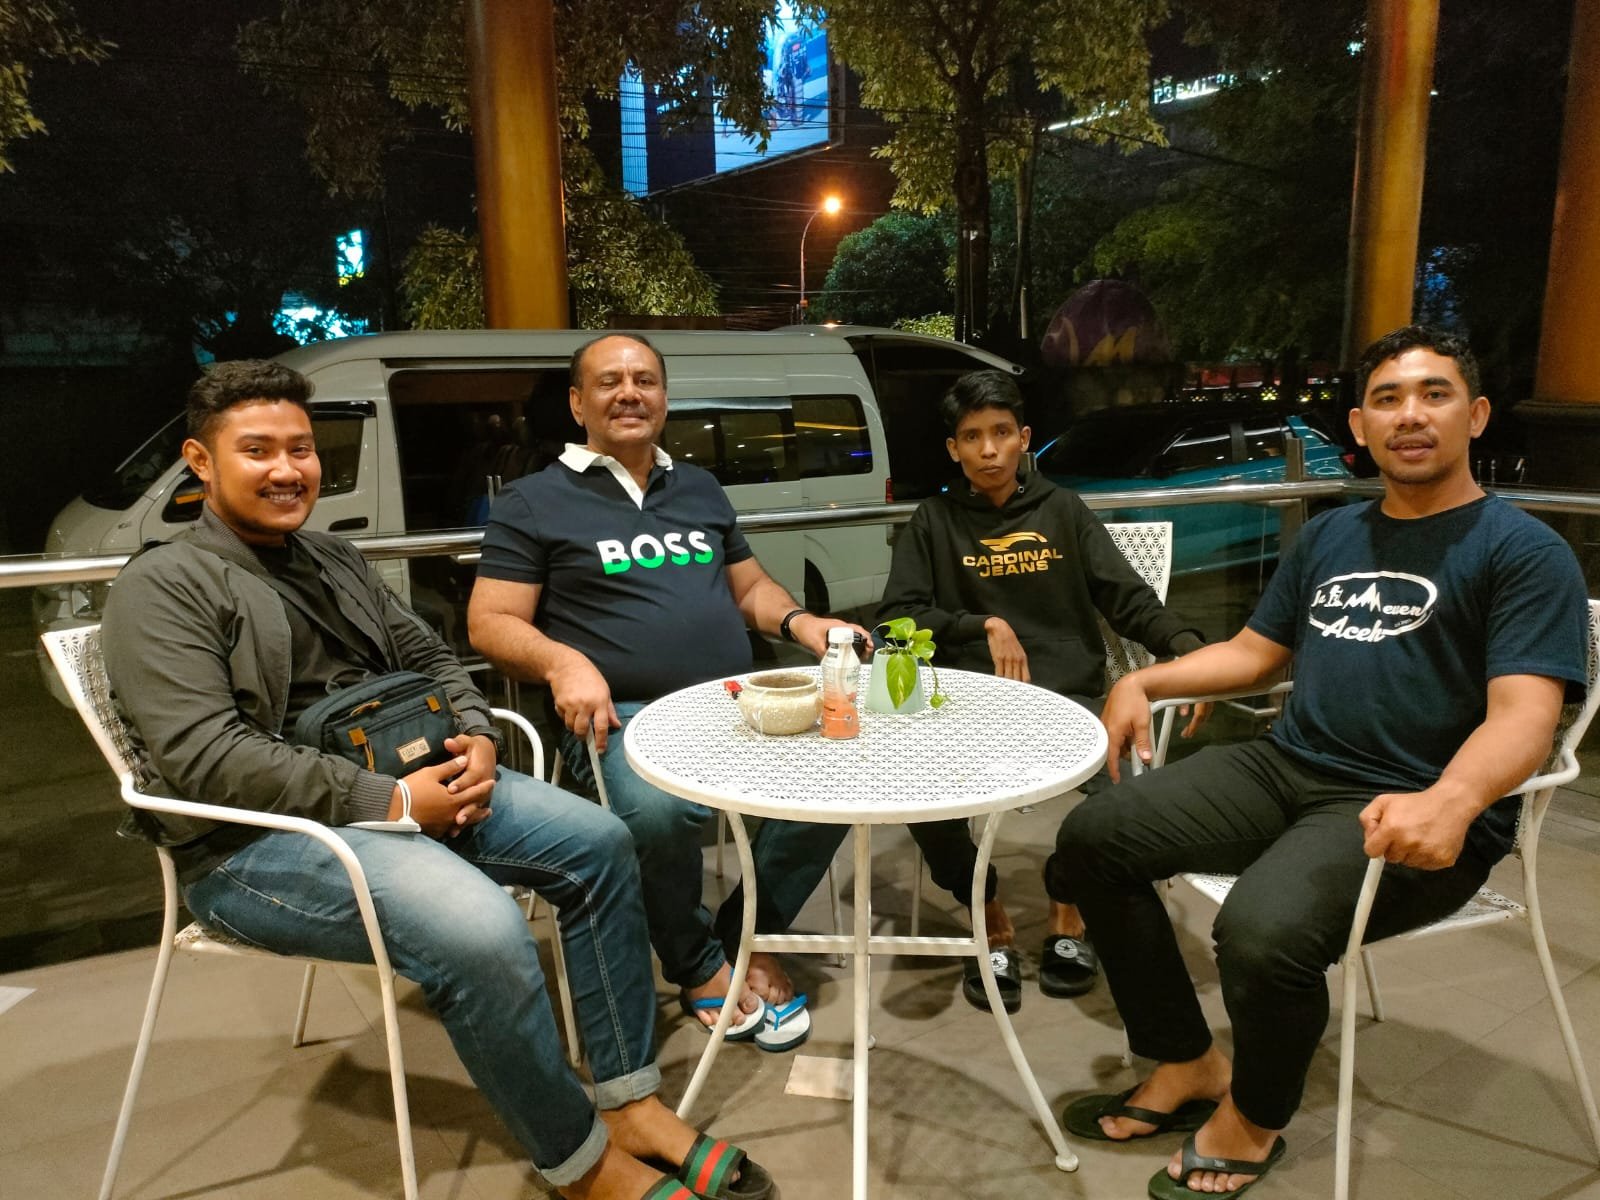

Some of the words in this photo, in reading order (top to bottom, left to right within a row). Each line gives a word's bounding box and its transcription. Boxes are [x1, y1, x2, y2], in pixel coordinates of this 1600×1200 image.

[596, 530, 714, 575] BOSS
[962, 547, 1063, 568] CARDINAL
[979, 559, 1049, 577] JEANS
[1321, 615, 1386, 642] Aceh
